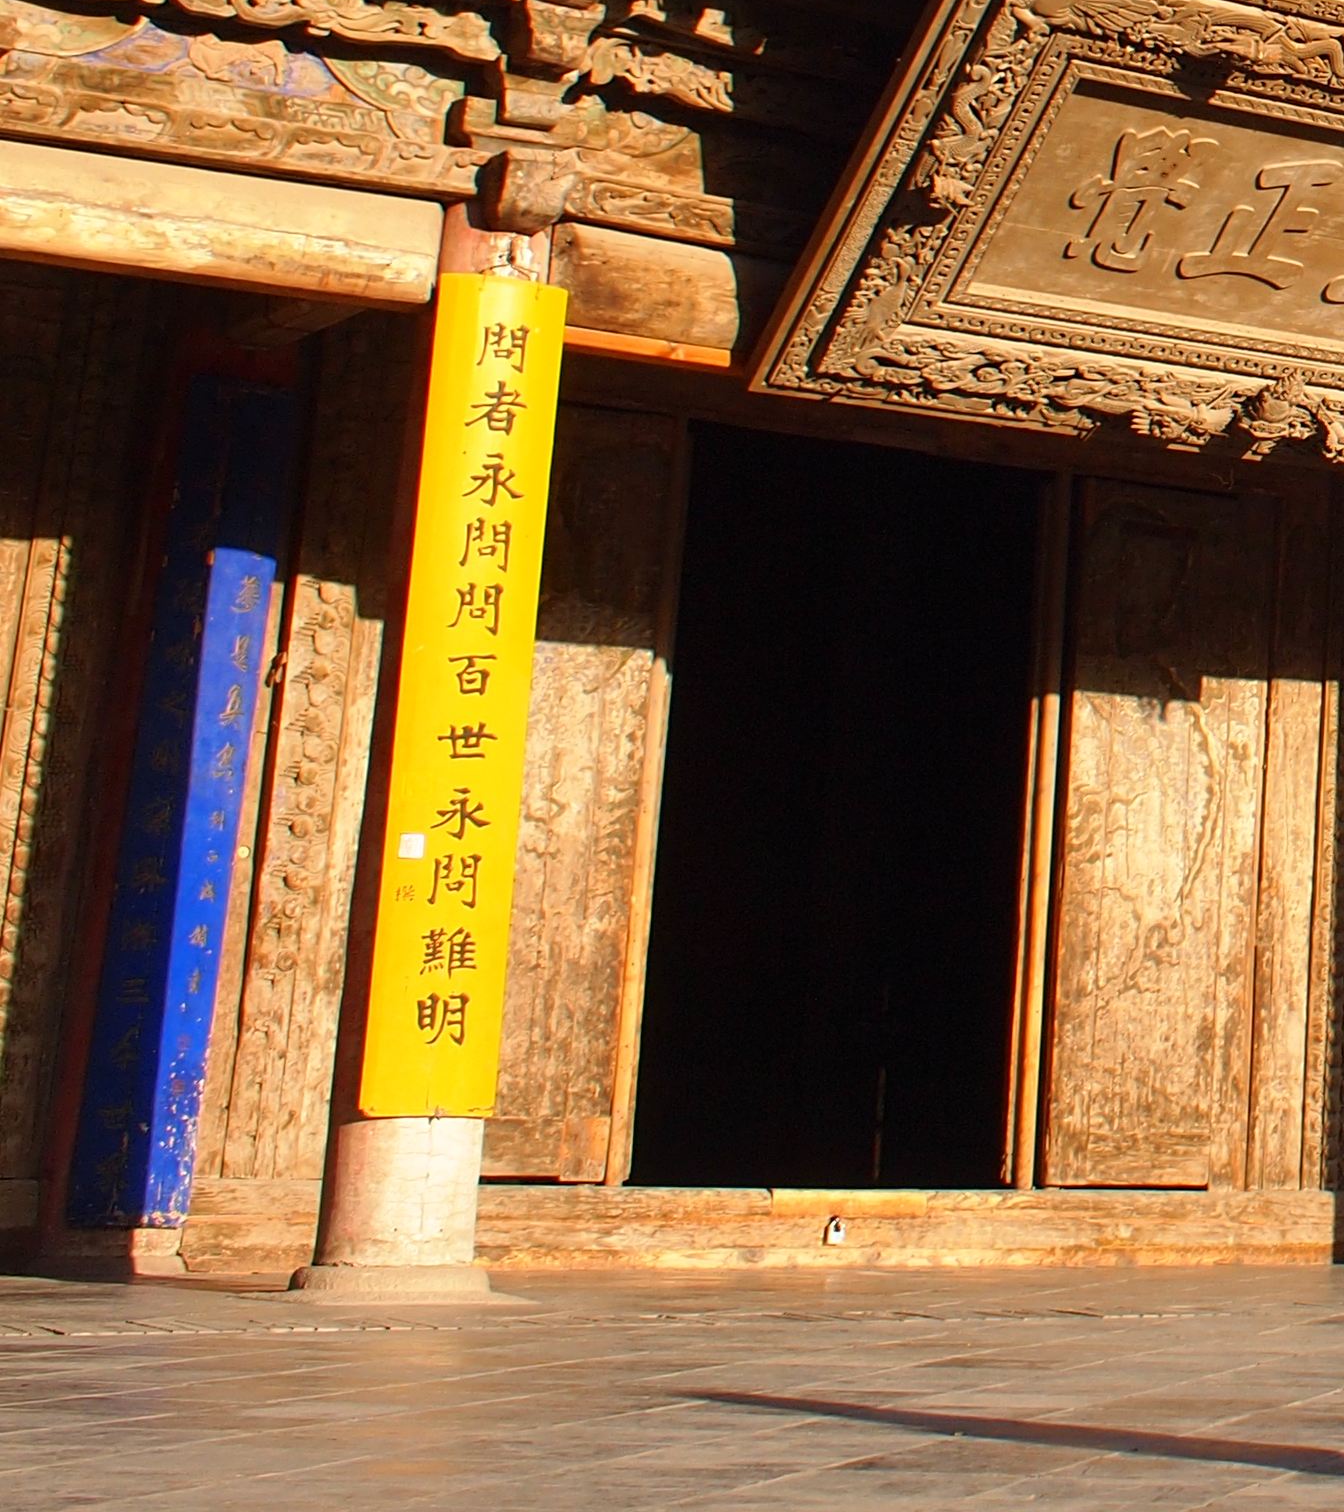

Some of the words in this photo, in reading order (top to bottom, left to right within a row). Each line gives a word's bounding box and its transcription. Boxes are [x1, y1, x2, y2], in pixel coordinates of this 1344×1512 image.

[415, 321, 530, 1047] 問者永問問百世永問難明
